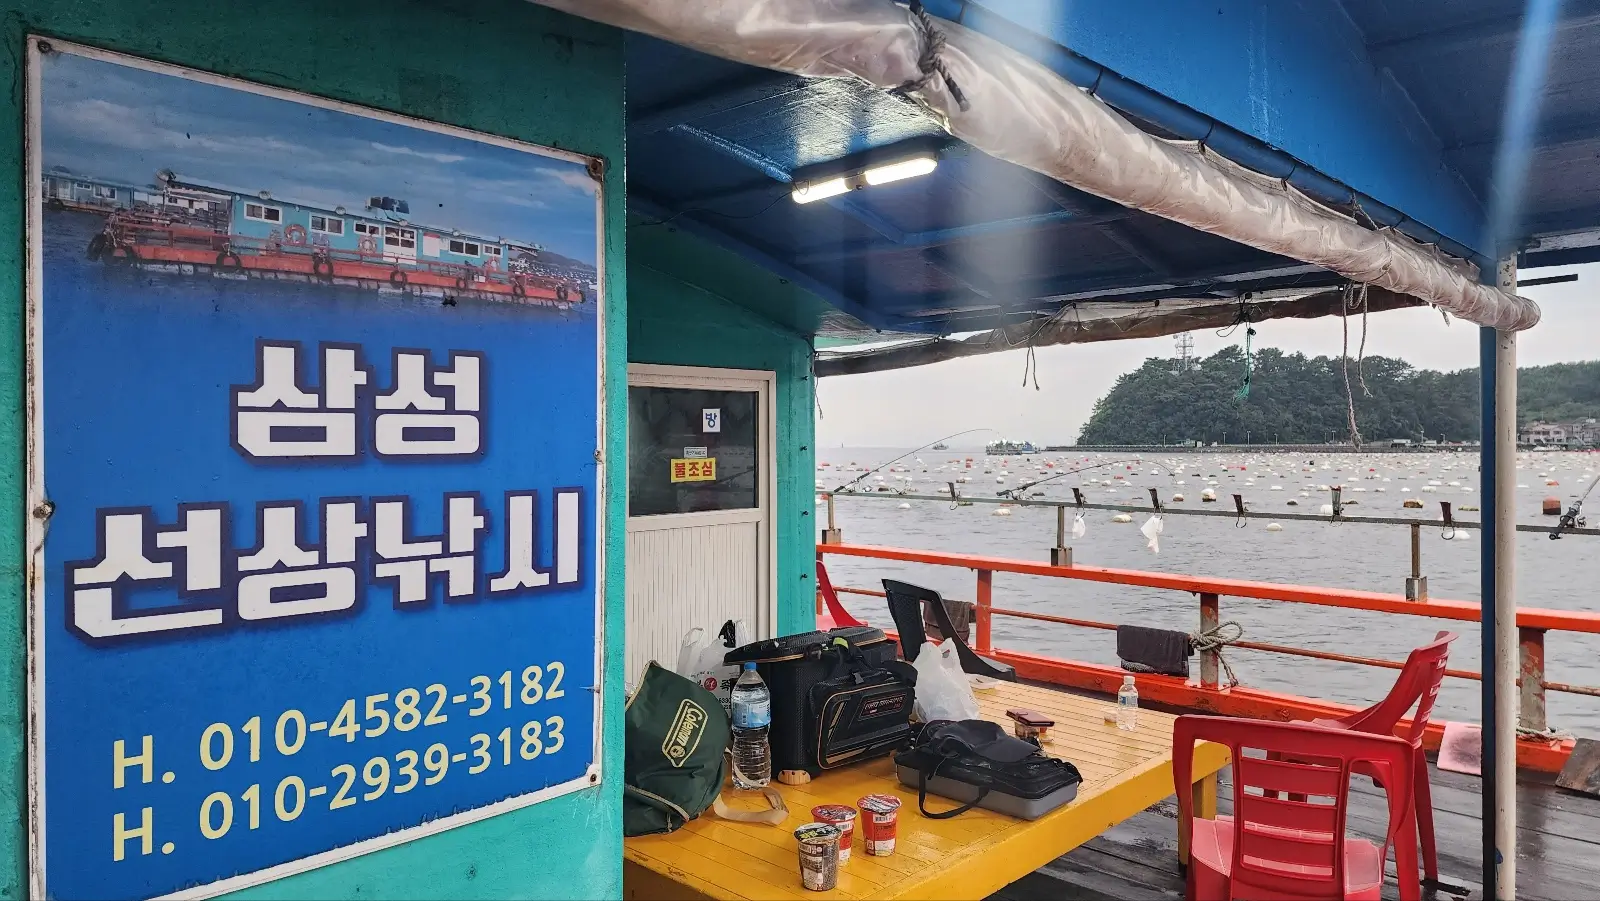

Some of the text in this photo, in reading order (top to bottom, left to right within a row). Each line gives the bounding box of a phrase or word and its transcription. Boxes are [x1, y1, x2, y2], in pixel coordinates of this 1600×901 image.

[235, 343, 482, 459] 삼성
[704, 412, 718, 429] 방
[673, 461, 713, 479] 불조심
[72, 490, 580, 639] 선상낚시
[113, 661, 566, 789] H. 010-4582-3182
[677, 707, 703, 747] Coleman
[113, 715, 566, 862] H. 010-2939-3183
